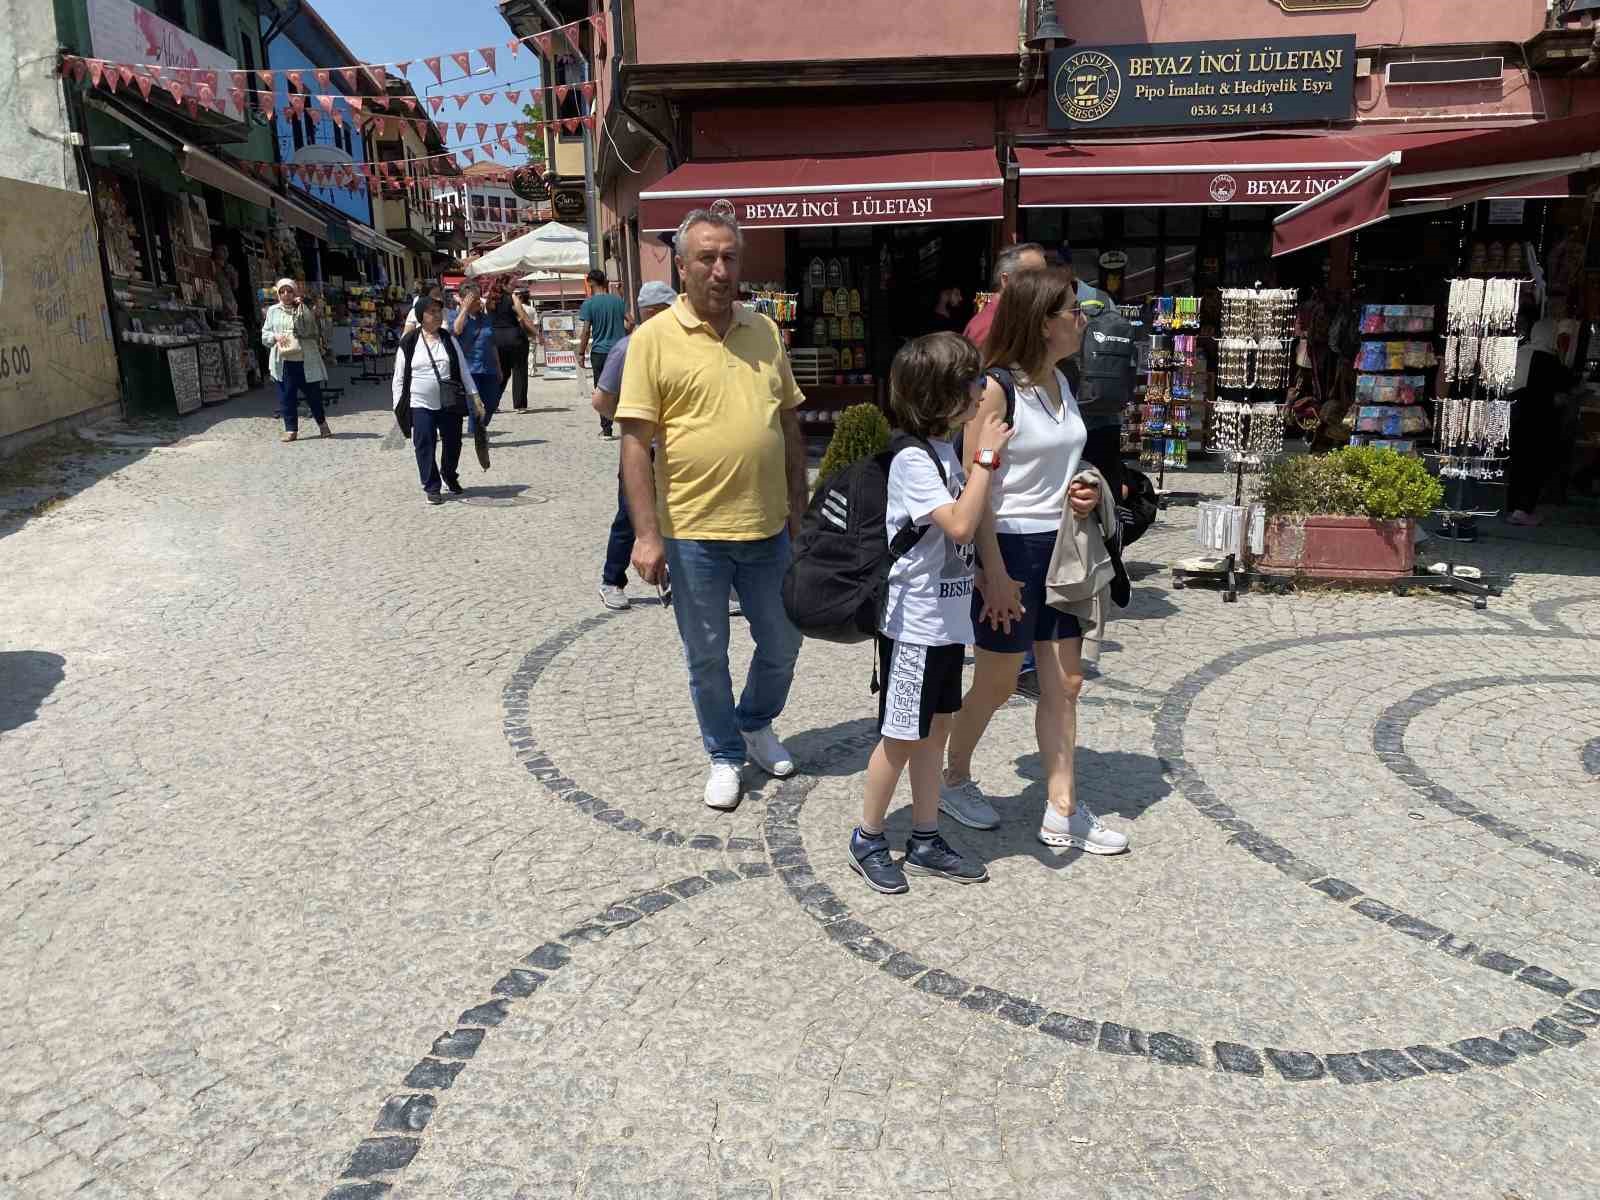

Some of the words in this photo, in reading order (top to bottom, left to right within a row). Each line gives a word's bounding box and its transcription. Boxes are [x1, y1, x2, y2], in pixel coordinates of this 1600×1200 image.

[1128, 56, 1193, 77] BEYAZ
[1199, 49, 1242, 74] İNCİ
[1248, 47, 1344, 73] LÜLETAŞI
[1135, 84, 1165, 101] Pipo
[1168, 80, 1215, 97] İmalatı
[1219, 82, 1230, 95] &
[1234, 79, 1297, 98] Hediyelik
[1302, 79, 1333, 95] Eşya
[1058, 88, 1118, 119] MEERSCHAUM
[1191, 103, 1217, 117] 0536
[1222, 103, 1240, 116] 254
[1244, 103, 1256, 115] 41
[1260, 102, 1273, 114] 43
[1247, 180, 1301, 195] BEYAZ
[746, 203, 798, 219] BEYAZ
[802, 198, 839, 217] İNCİ
[852, 196, 933, 217] LÜLETAŞI
